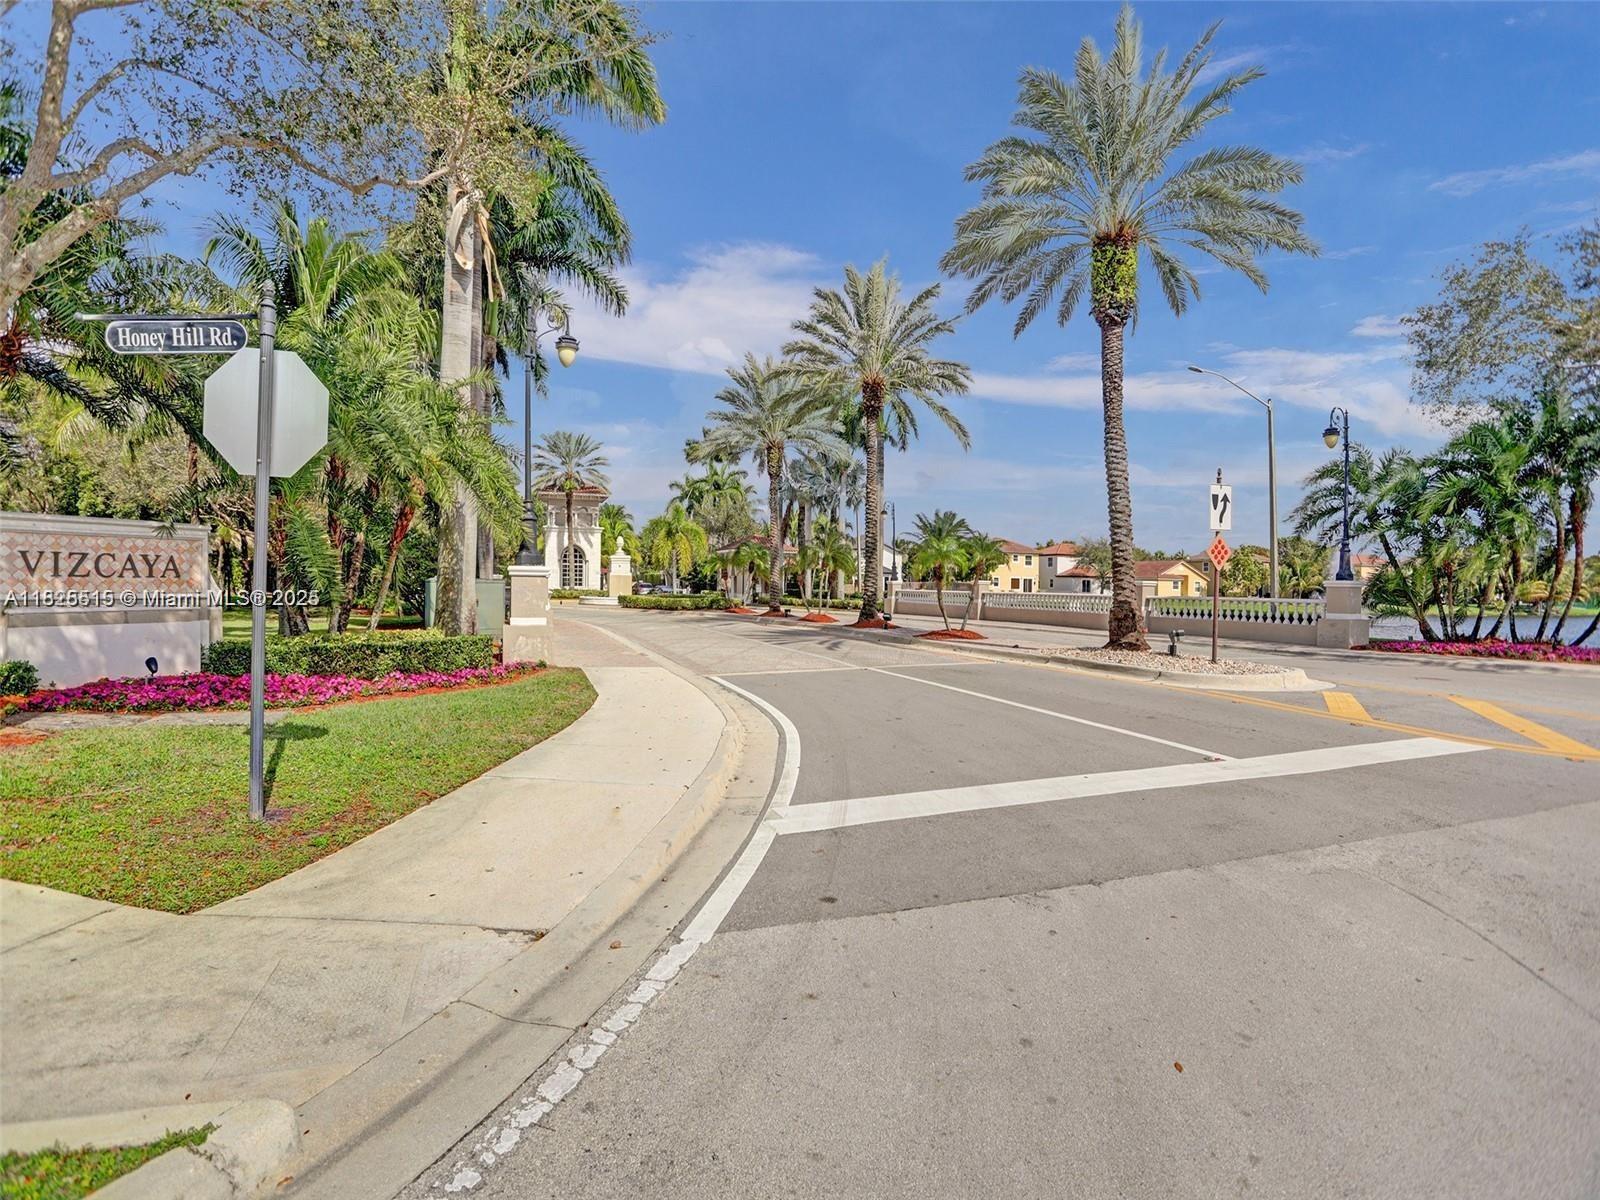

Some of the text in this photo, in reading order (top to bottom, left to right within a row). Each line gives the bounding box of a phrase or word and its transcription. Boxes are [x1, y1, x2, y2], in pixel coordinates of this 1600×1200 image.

[116, 326, 238, 351] Honey Hill Rd.
[18, 550, 182, 579] VIZCAYA
